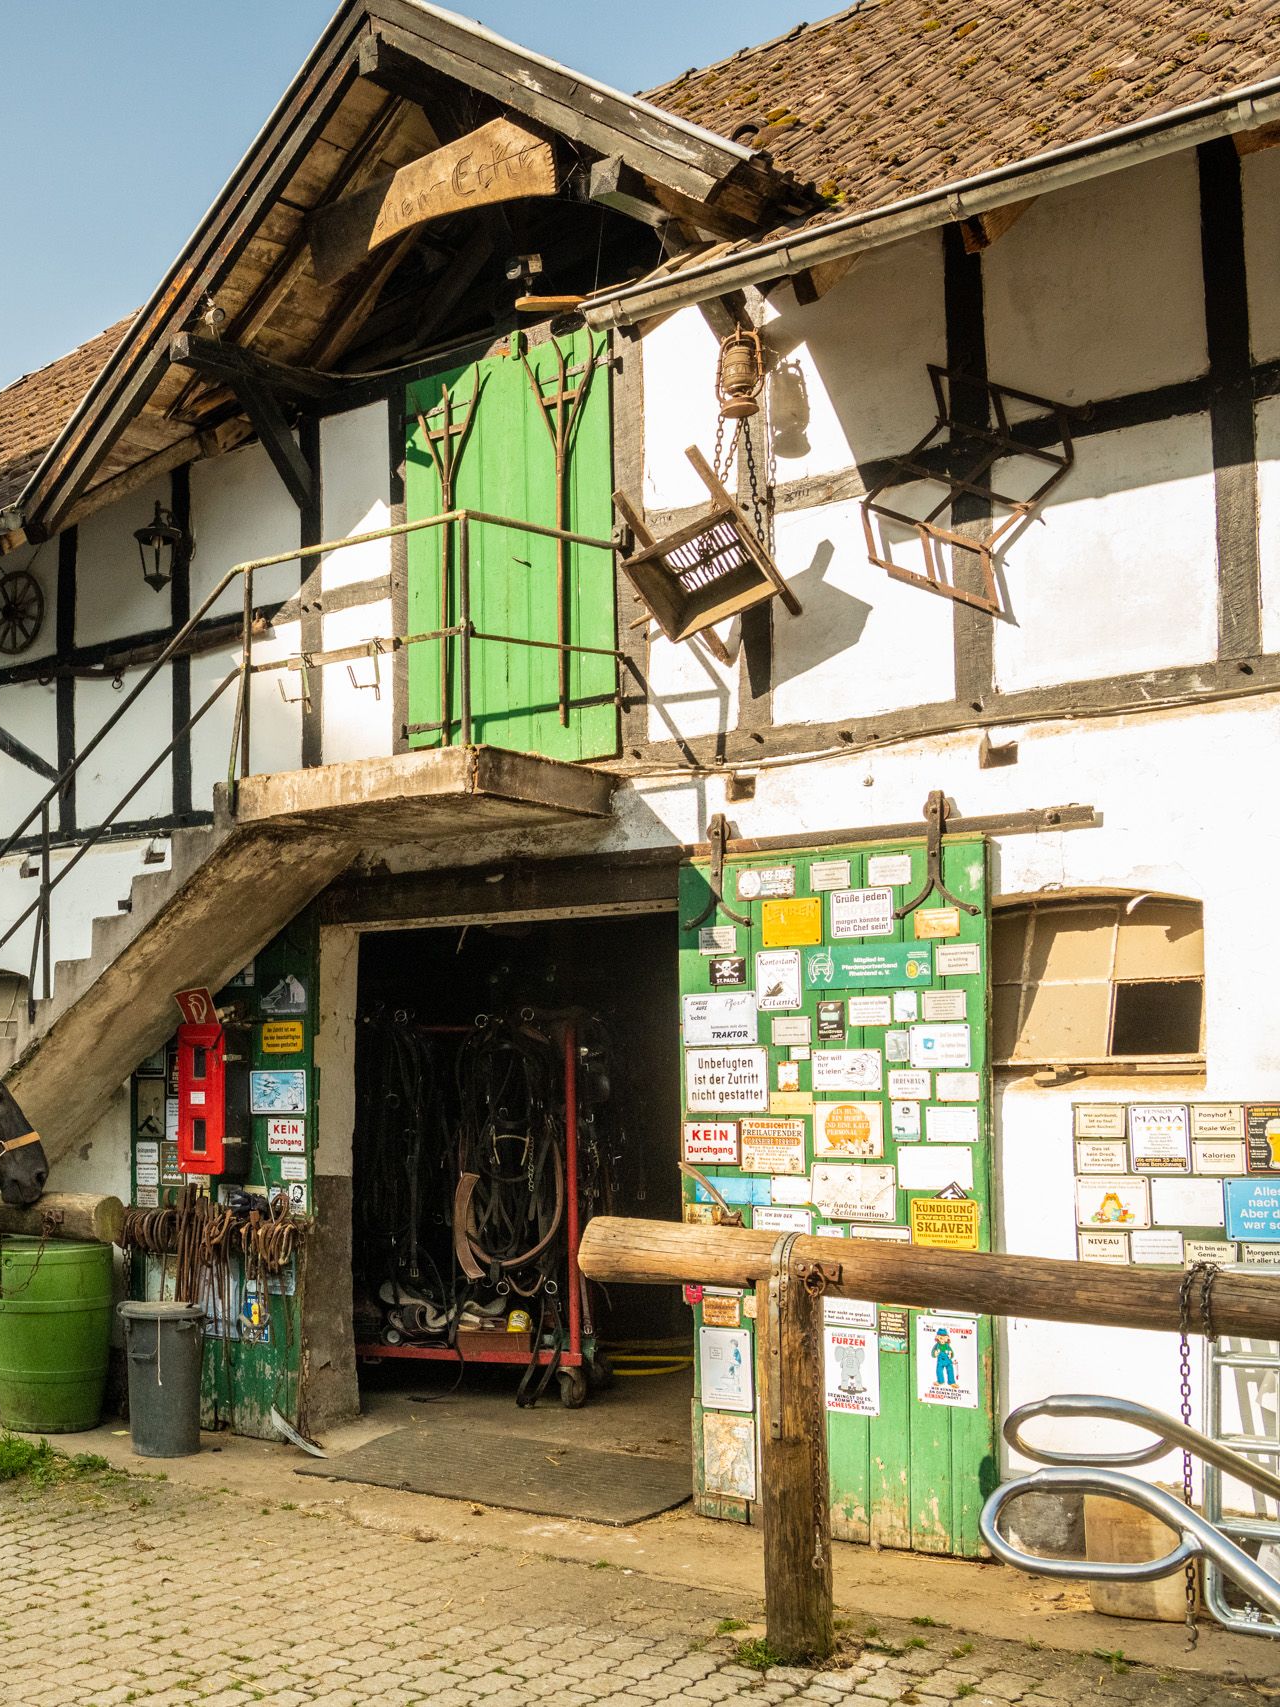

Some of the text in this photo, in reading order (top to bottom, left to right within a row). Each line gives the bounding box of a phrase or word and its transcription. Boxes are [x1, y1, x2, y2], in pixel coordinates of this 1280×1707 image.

[835, 892, 888, 904] Grüße jeden
[835, 918, 858, 926] morgen
[836, 925, 851, 933] Dein
[852, 923, 869, 932] Chef
[711, 1030, 748, 1039] TRAKTOR
[697, 1057, 753, 1071] Unbefugten
[694, 1072, 759, 1085] ist der Zutritt
[691, 1089, 763, 1103] nicht gestattet
[1134, 1115, 1183, 1123] MAMA
[273, 1124, 299, 1134] KEIN
[742, 1129, 802, 1137] FREILAUFENDER
[692, 1129, 729, 1141] KEIN
[270, 1138, 302, 1146] Durchgang
[687, 1145, 734, 1155] Durchgang
[817, 1200, 831, 1208] Sie
[833, 1201, 857, 1209] haben
[1248, 1198, 1279, 1208] nach
[830, 1207, 889, 1219] Reklamation?
[1240, 1208, 1270, 1219] Aber
[916, 1222, 973, 1234] SKLAVEN
[1243, 1221, 1266, 1229] war
[1246, 1249, 1280, 1258] Morgenst
[831, 1336, 866, 1347] FURZEN
[827, 1401, 860, 1411] SCHEISSE
